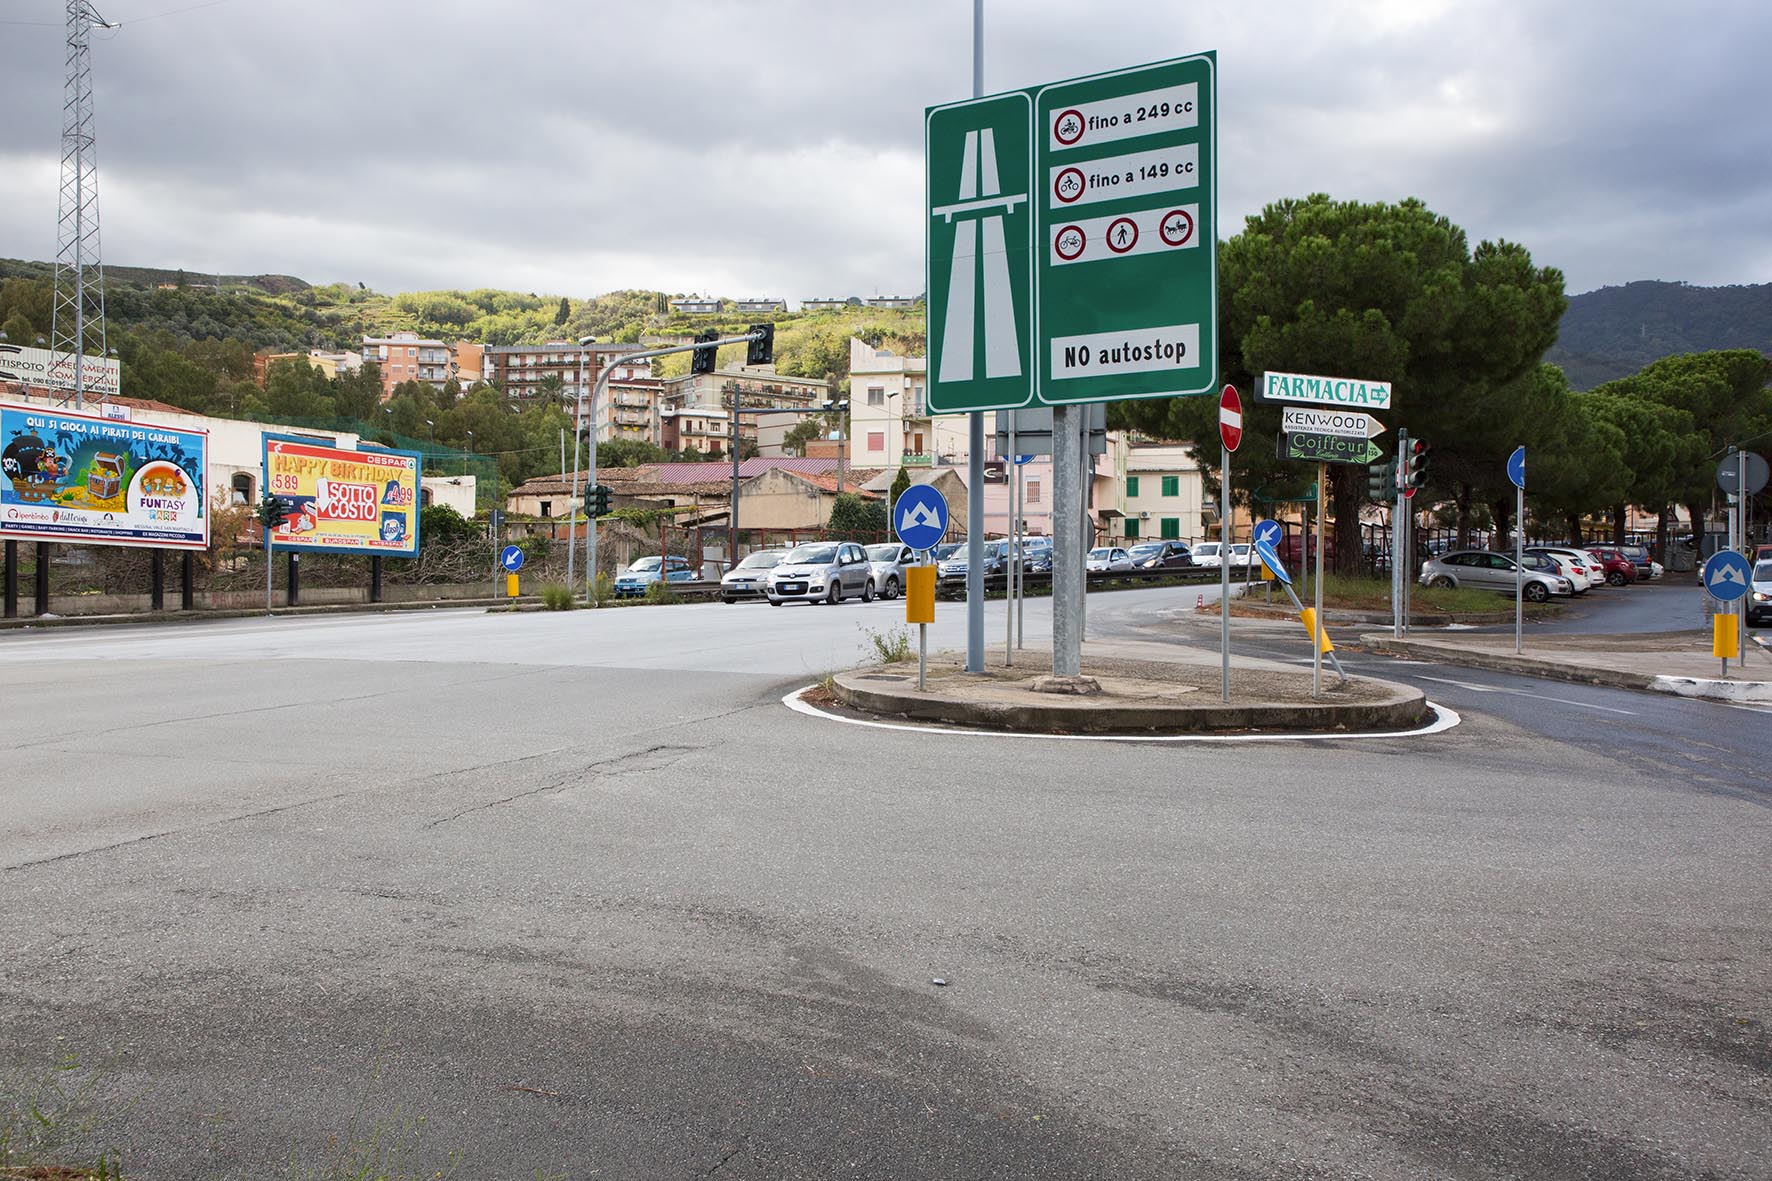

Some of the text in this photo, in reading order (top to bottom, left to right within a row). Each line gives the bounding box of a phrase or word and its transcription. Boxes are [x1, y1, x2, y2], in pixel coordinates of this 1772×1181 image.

[1089, 100, 1193, 131] fino a 249 cc
[1089, 160, 1194, 188] fino a 149 cc
[1065, 340, 1187, 368] NO autostop
[1268, 375, 1369, 403] FARMACIA
[26, 417, 45, 428] QUI
[48, 419, 57, 430] SI
[60, 421, 87, 433] GIOCA
[90, 425, 99, 435] AI
[102, 427, 129, 438] PIRATI
[132, 430, 146, 440] DEI
[1285, 412, 1366, 430] KENWOOD
[1293, 433, 1363, 453] Coiffeur
[275, 455, 402, 482] HAPPY BIRTHDAY
[367, 456, 407, 467] DESPAR
[330, 483, 375, 503] SOTTO
[140, 497, 186, 510] FUNTASY
[328, 500, 376, 520] COSTO
[149, 510, 178, 522] PARK
